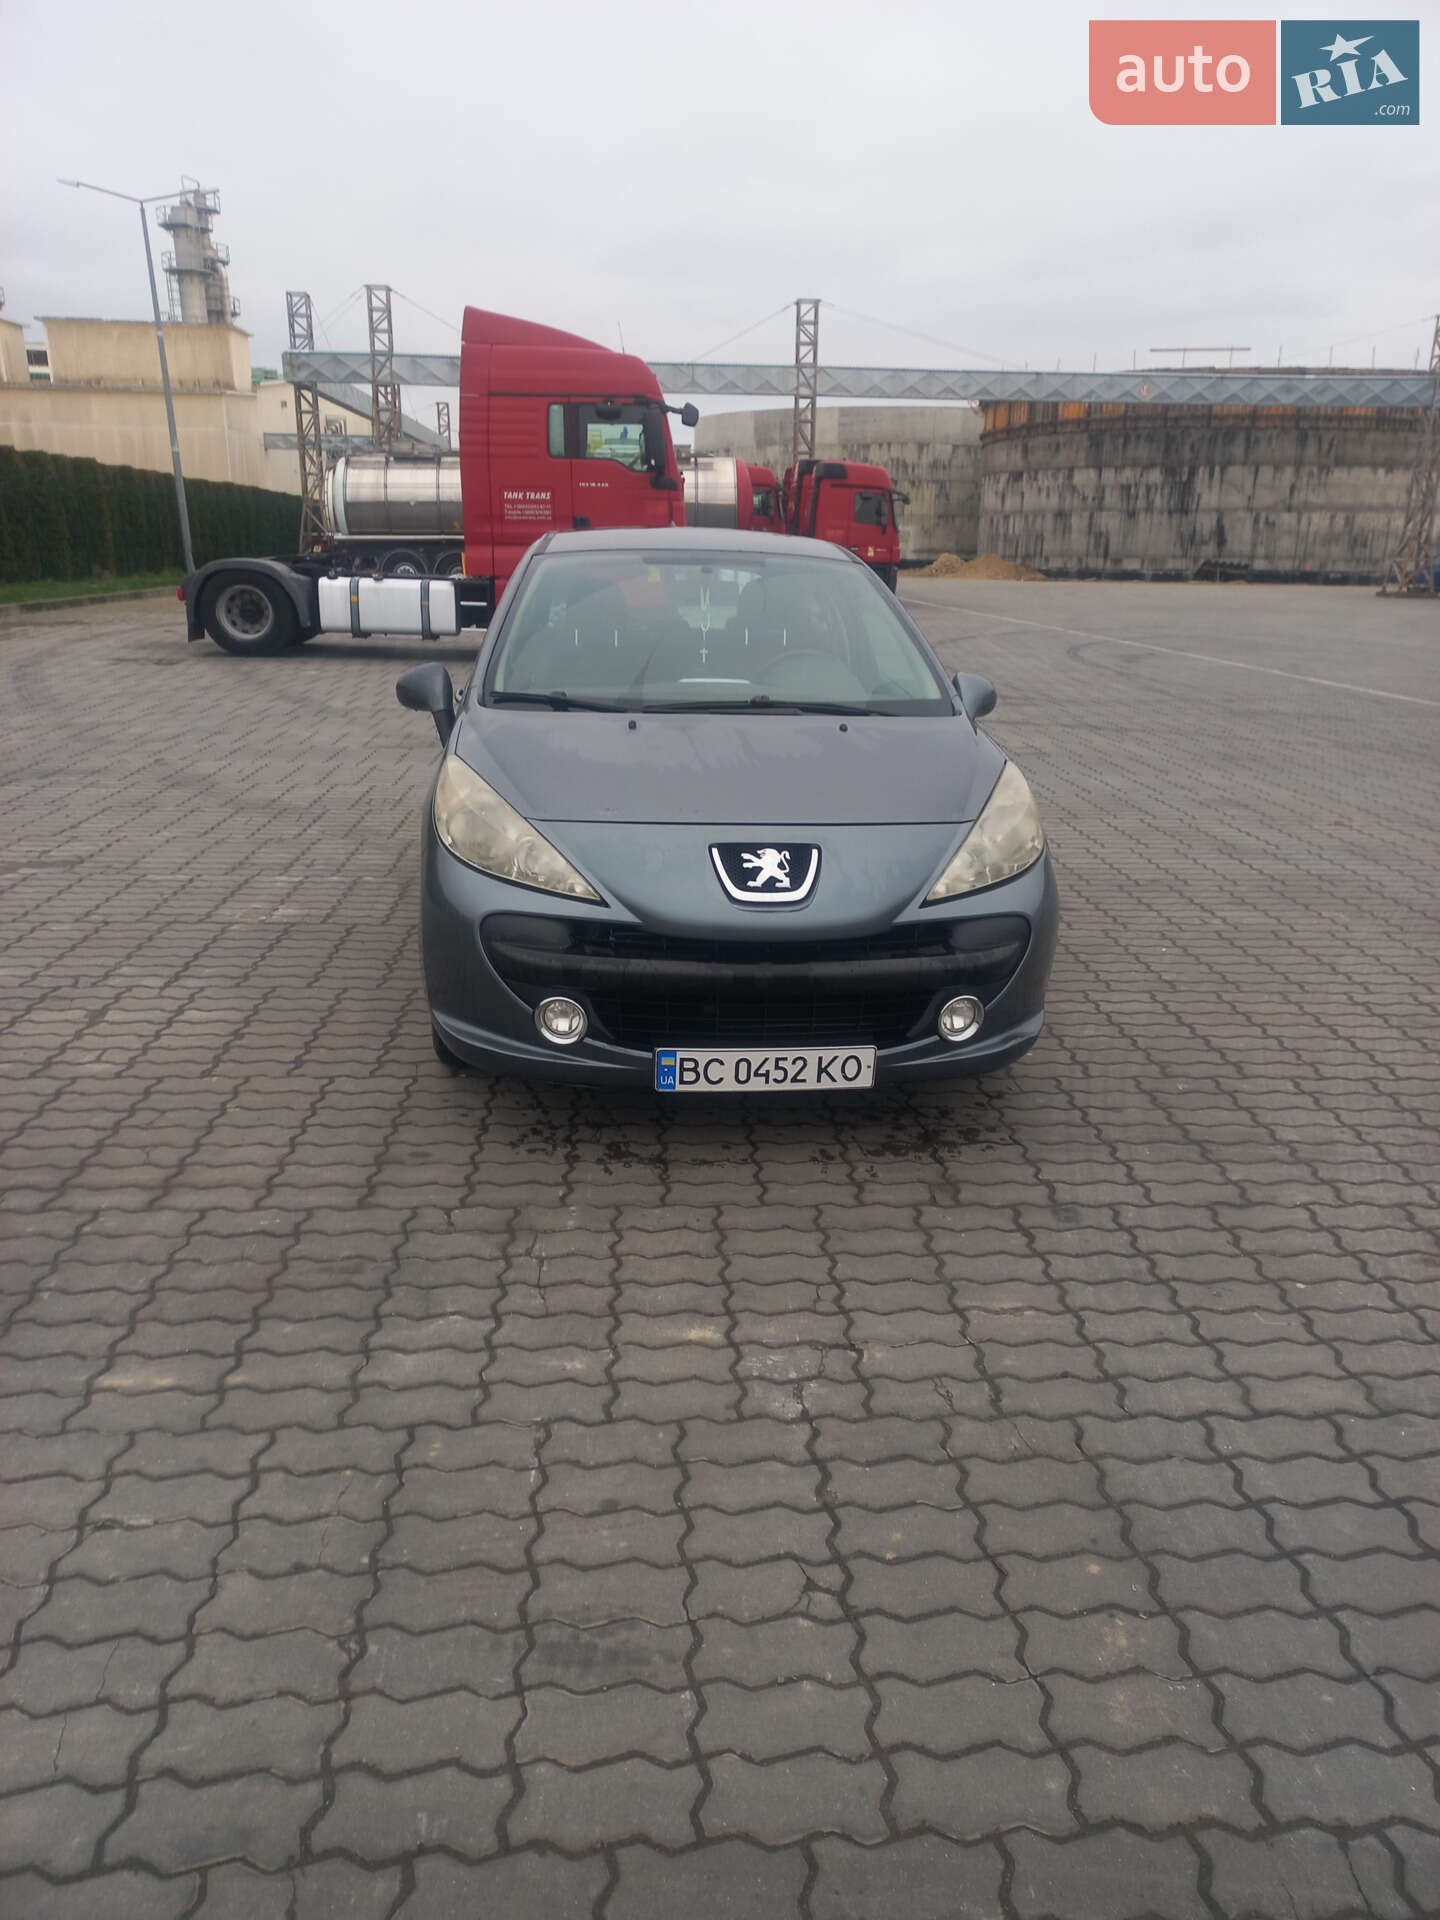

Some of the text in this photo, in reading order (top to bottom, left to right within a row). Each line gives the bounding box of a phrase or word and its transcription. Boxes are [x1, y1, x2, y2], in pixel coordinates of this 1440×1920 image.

[503, 491, 552, 500] TANK TRANS
[678, 1054, 863, 1085] BC 0452 KO
[660, 1075, 674, 1085] UA
